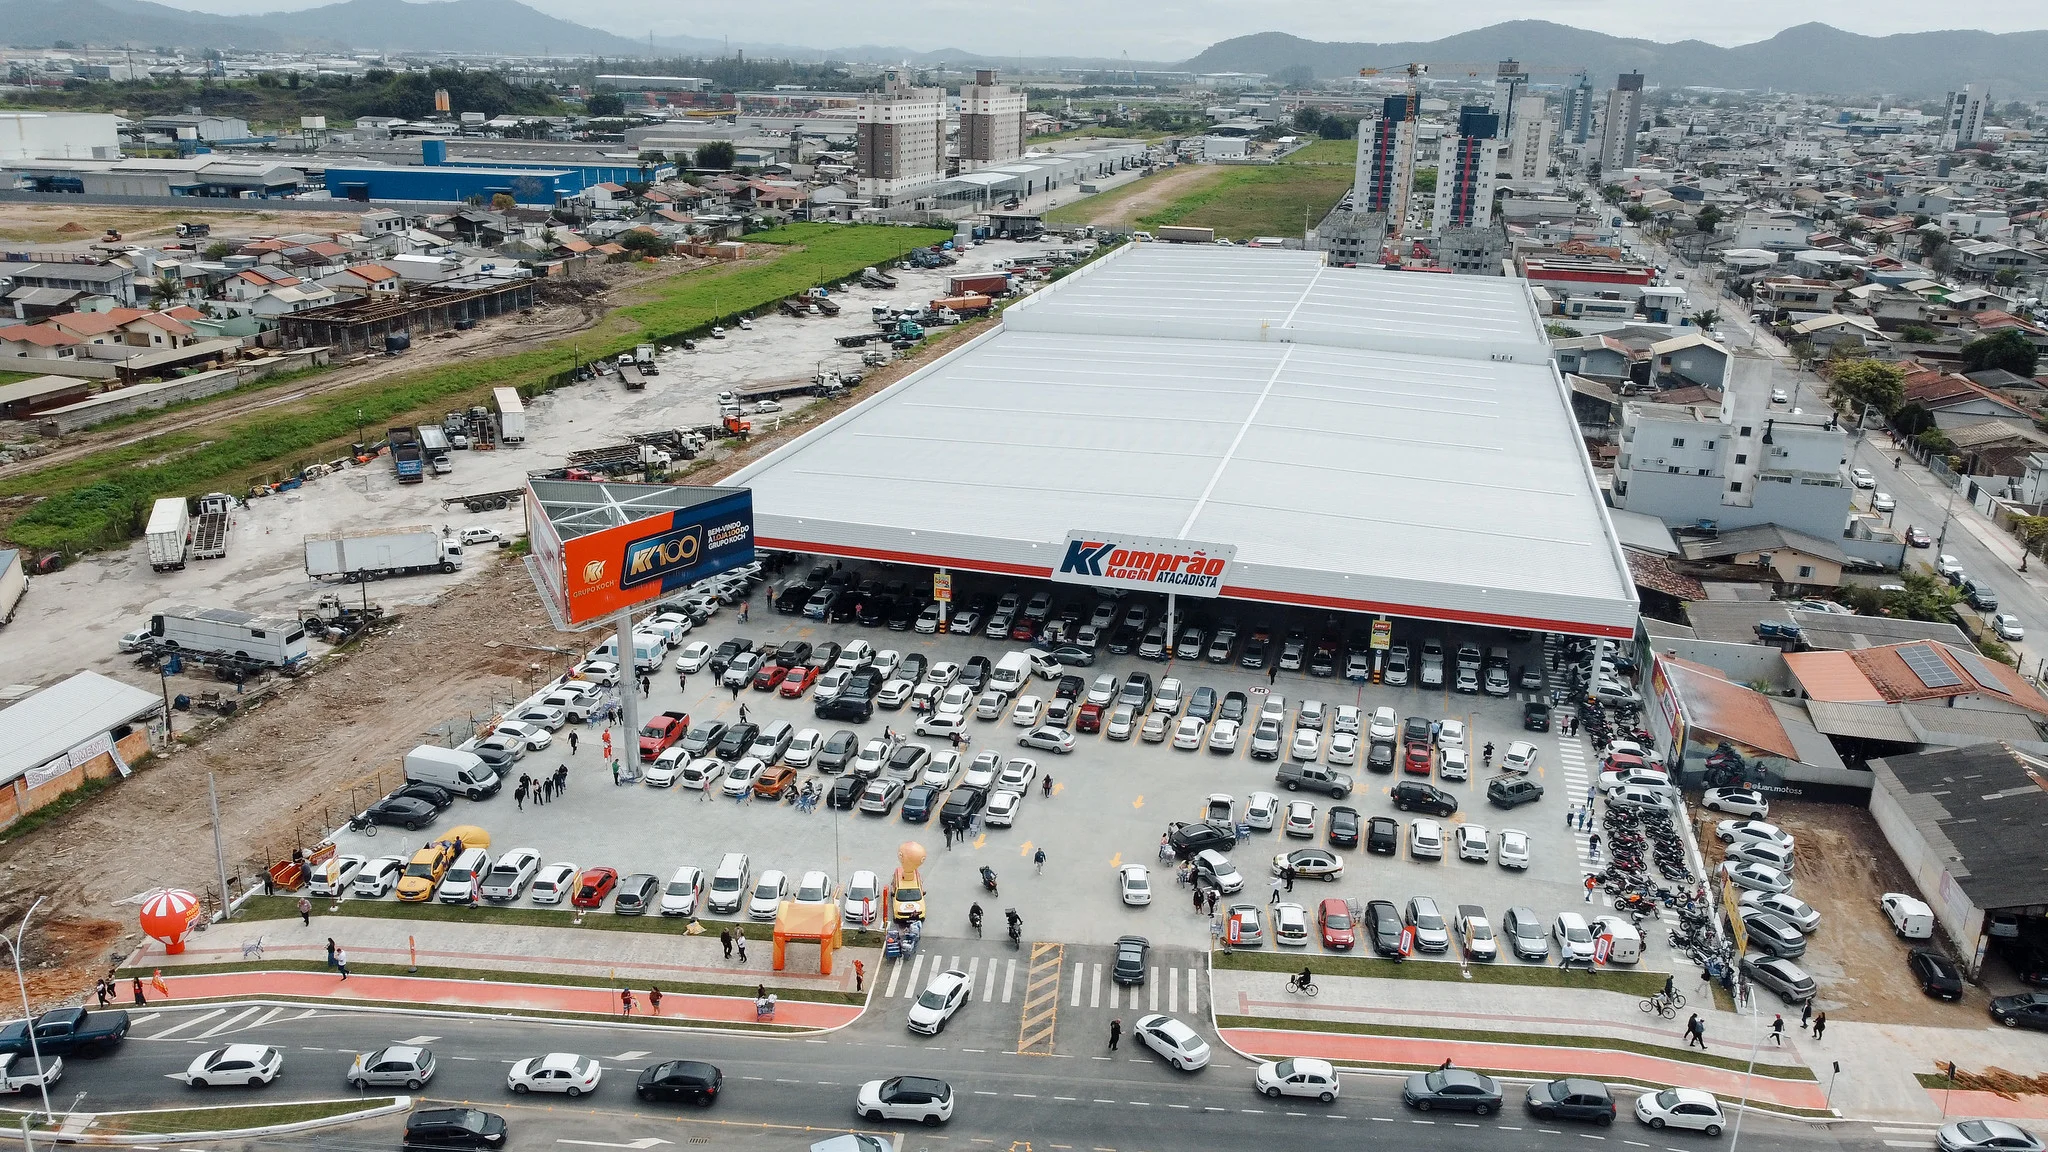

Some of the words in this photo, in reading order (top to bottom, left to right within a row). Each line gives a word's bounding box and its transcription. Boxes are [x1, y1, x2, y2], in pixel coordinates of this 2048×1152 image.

[708, 521, 741, 536] BEM-VINDO
[713, 532, 728, 541] LOJA
[728, 528, 740, 537] 100
[740, 525, 749, 533] DO
[708, 538, 728, 550] GRUPO
[729, 532, 746, 543] KOCH
[1156, 571, 1218, 588] ATACADISTA
[573, 586, 596, 598] GRUPO
[596, 579, 615, 591] KOCH
